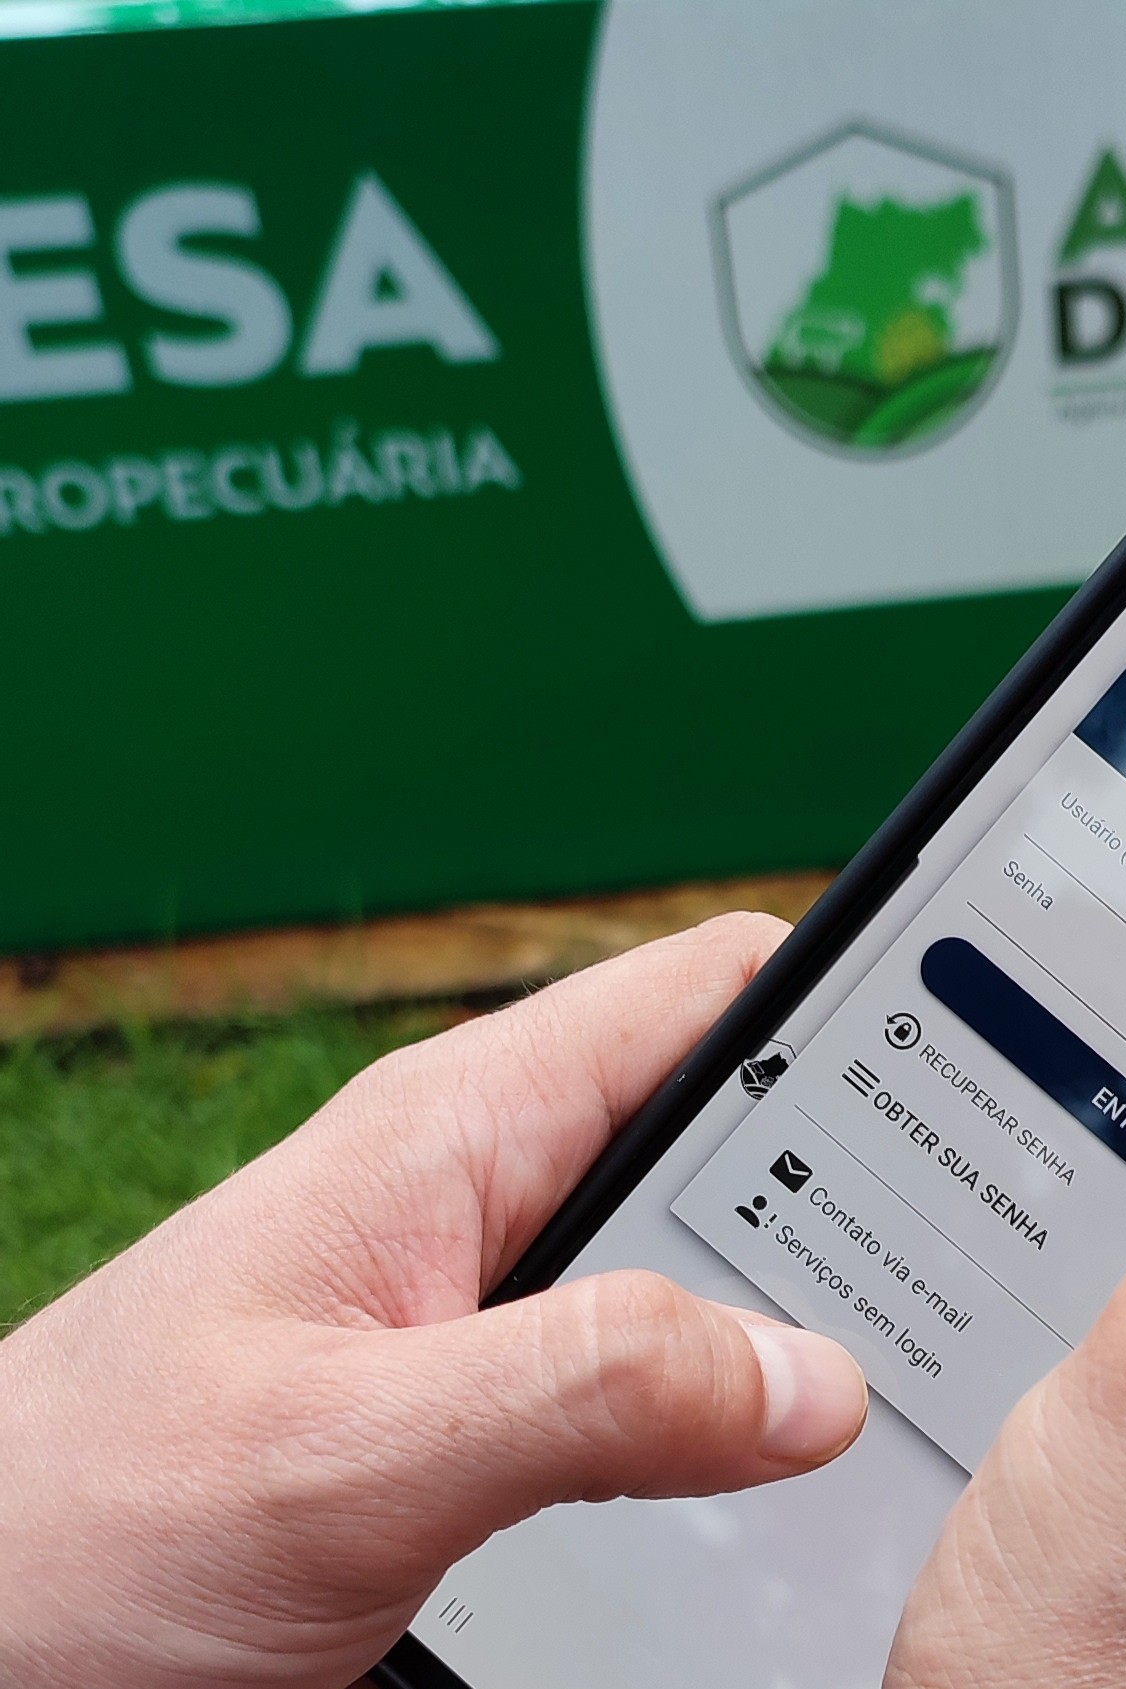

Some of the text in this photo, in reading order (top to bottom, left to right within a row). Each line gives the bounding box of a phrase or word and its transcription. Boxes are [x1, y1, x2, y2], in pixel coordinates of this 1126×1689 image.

[1003, 861, 1054, 911] Senha
[1060, 792, 1121, 851] Usuário
[873, 1091, 1049, 1251] OBTER SUA SENHA
[918, 1043, 1076, 1187] RECUPERAR SENHA
[775, 1225, 943, 1380] Serviços sem login
[809, 1187, 974, 1334] Contato via e-mail
